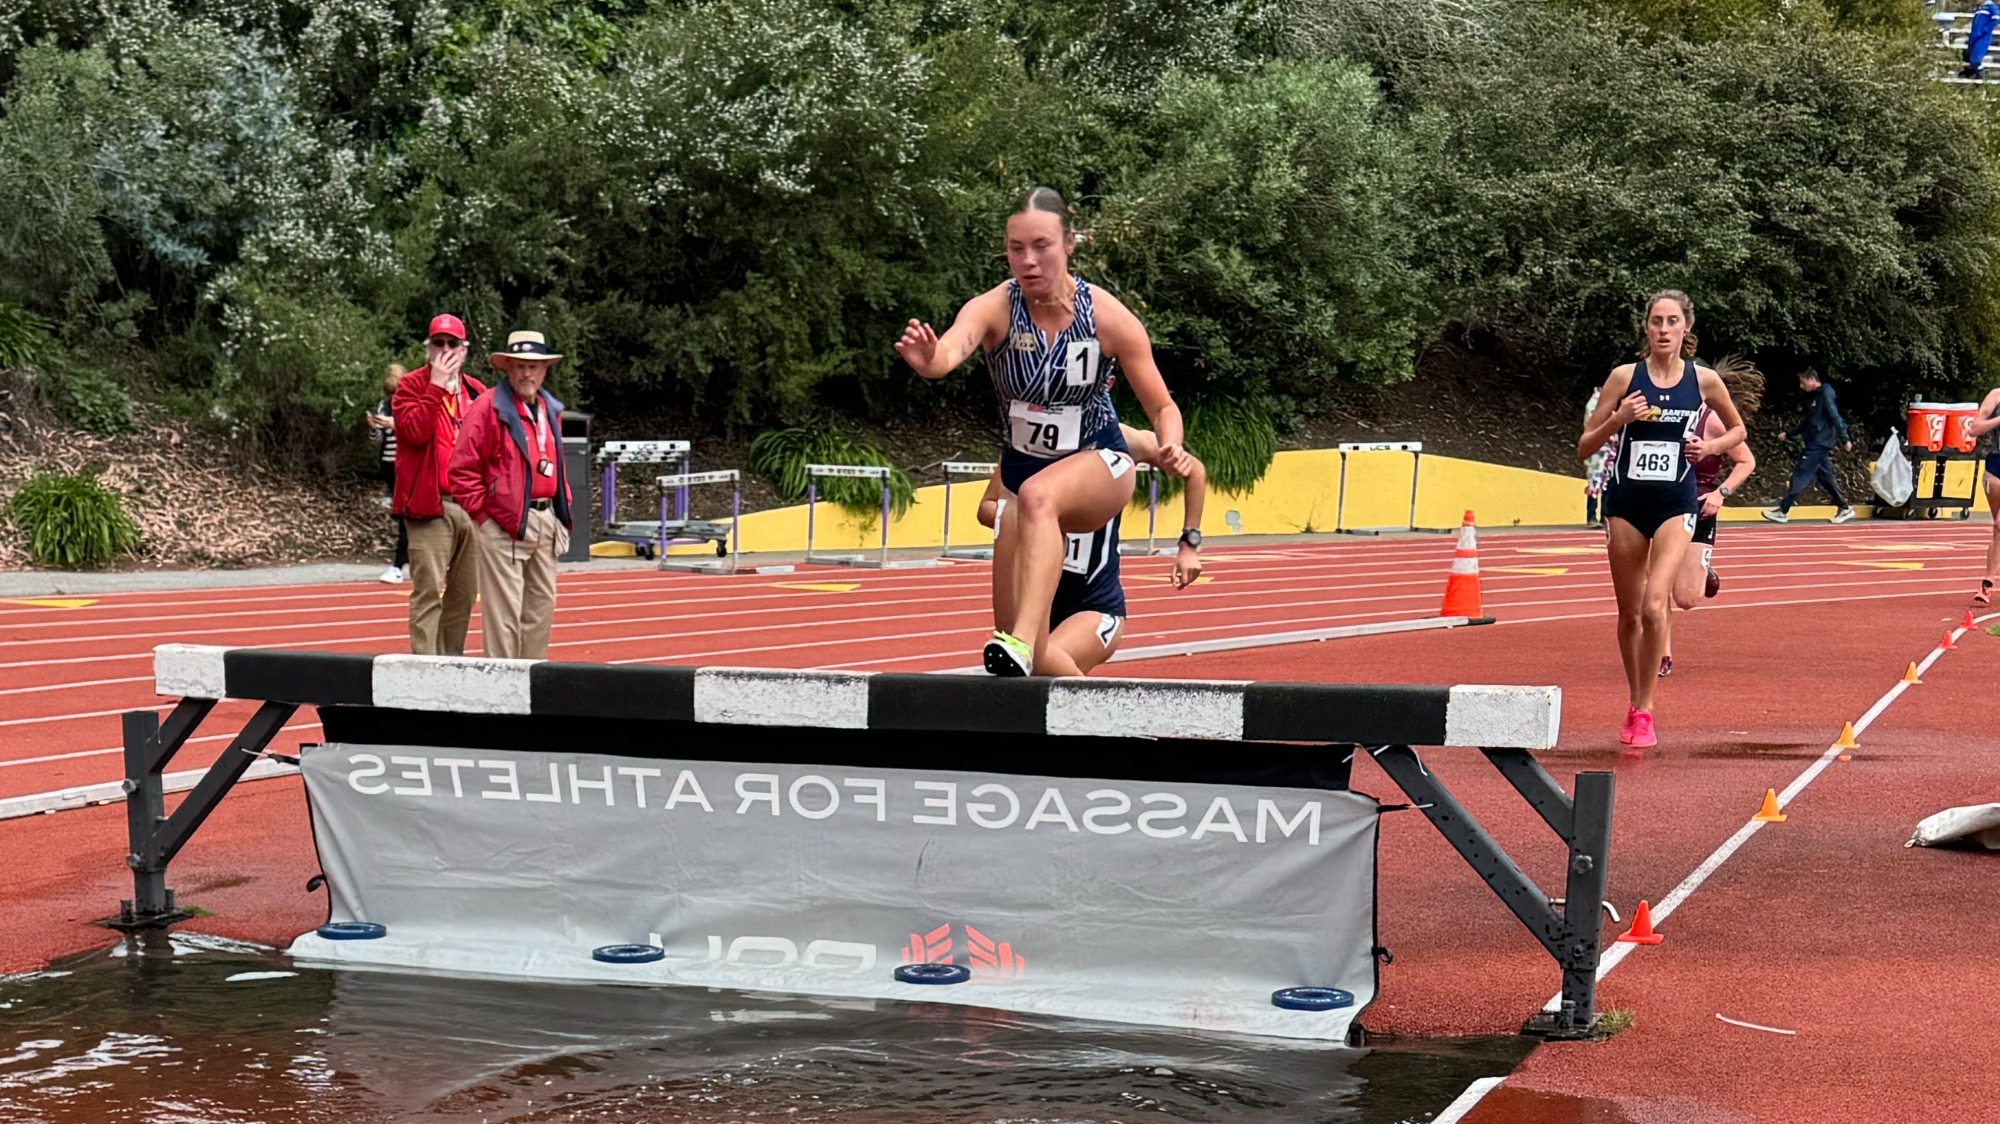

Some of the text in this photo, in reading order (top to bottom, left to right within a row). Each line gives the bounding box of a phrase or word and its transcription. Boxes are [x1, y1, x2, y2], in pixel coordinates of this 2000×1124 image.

[1075, 346, 1089, 382] 1
[1026, 421, 1060, 451] 79
[1636, 453, 1670, 472] 463
[1100, 614, 1117, 645] 2
